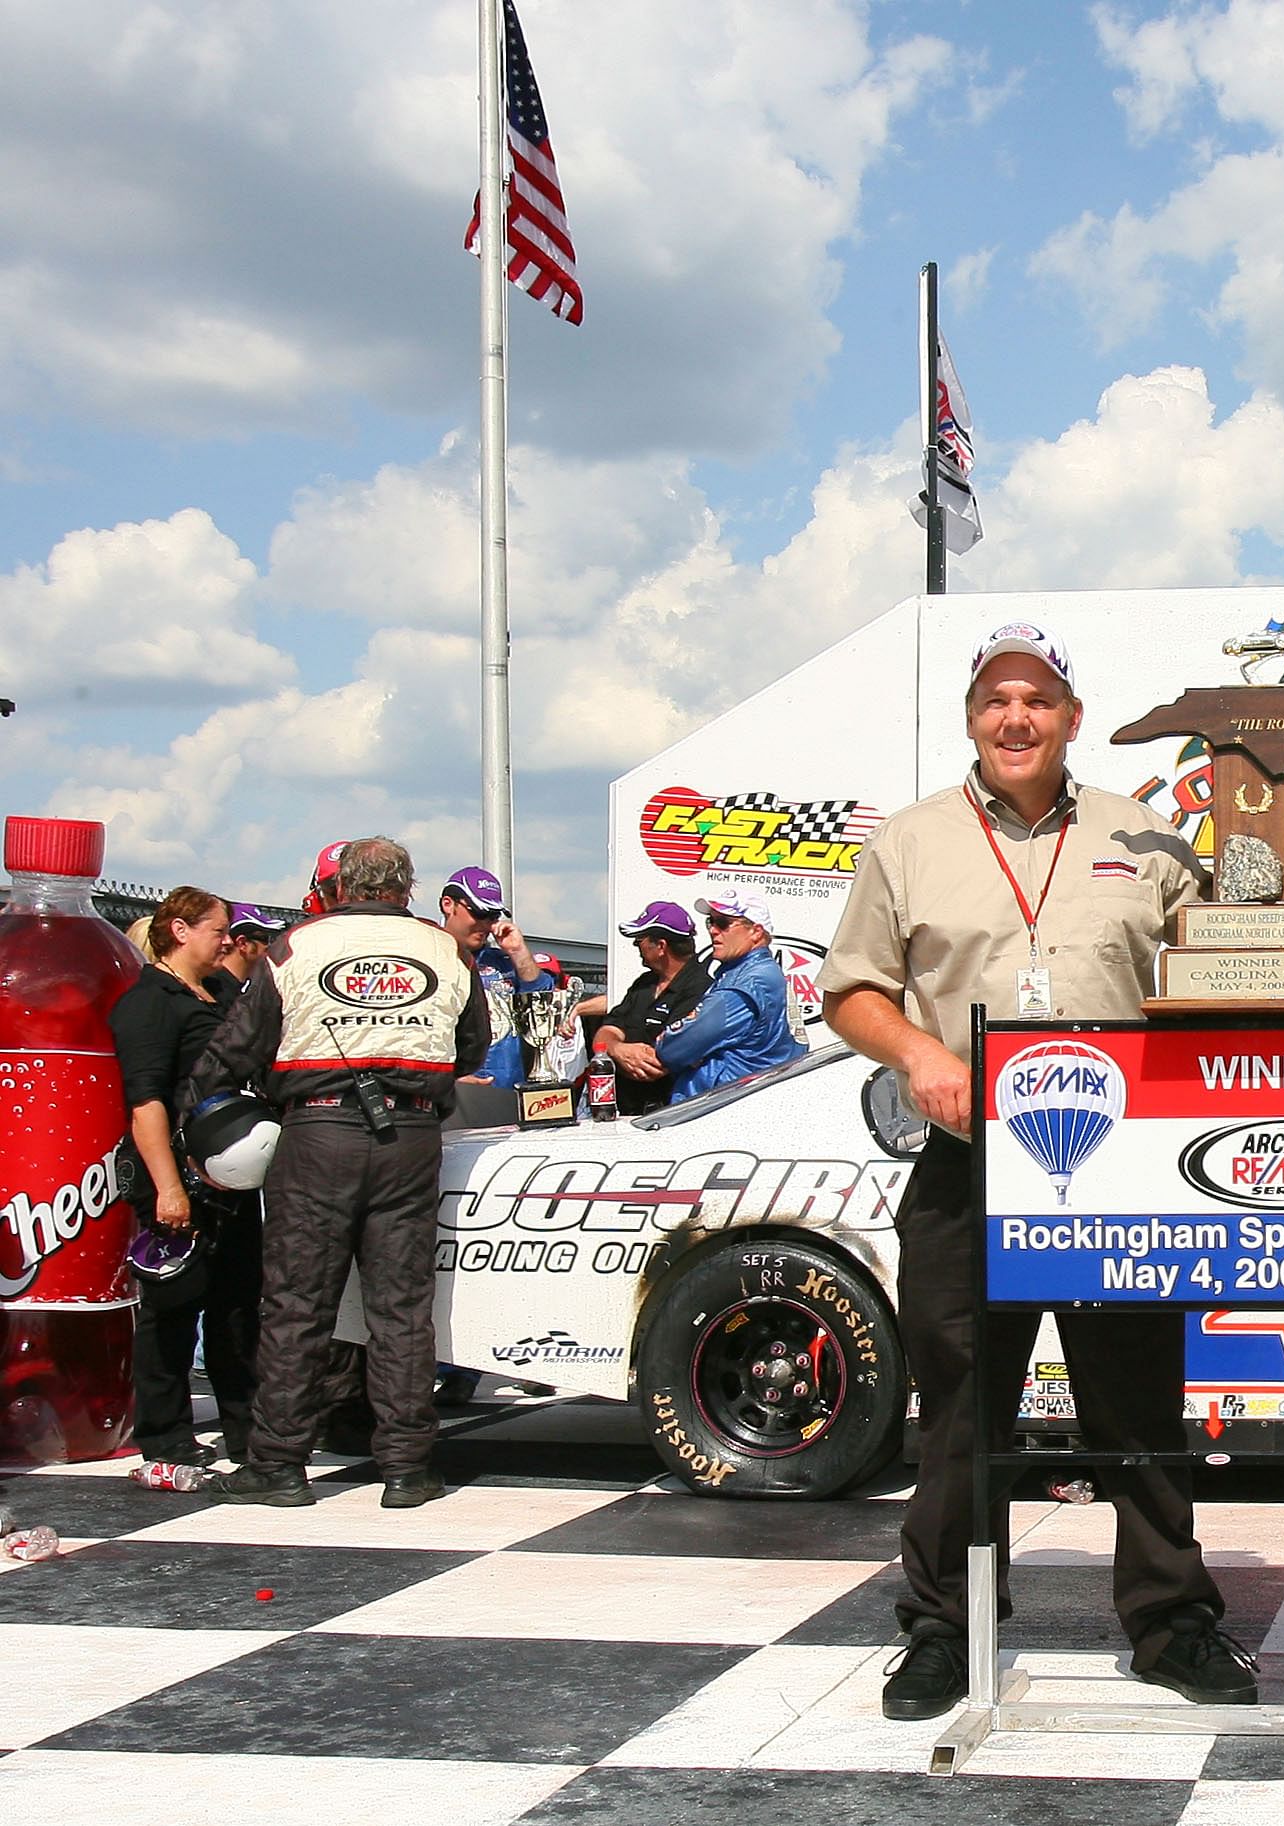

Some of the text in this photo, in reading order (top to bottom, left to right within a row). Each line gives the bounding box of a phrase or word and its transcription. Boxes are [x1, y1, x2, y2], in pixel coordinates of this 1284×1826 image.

[652, 804, 792, 838] FAST
[700, 834, 863, 871] TRACK
[706, 872, 847, 890] HIGH PERFORMANCE DRIVING
[1207, 913, 1257, 925] ROCKINGHAM
[353, 963, 389, 975] ARCA
[1218, 958, 1281, 968] WINNER
[1190, 970, 1279, 980] CAROLINA
[346, 976, 416, 994] RE/MAX
[1209, 982, 1242, 991] MAY
[321, 1015, 433, 1027] OFFICIAL
[1013, 1063, 1109, 1101] RE/MAX
[1002, 1217, 1229, 1257] Rockingham
[436, 1240, 579, 1273] ACING
[741, 1254, 770, 1266] SET
[760, 1269, 786, 1288] RR
[1102, 1259, 1182, 1298] May
[1190, 1258, 1224, 1297] 4,
[795, 1267, 879, 1364] Hoosier
[492, 1346, 625, 1358] VENTURINI
[1036, 1382, 1073, 1394] JES
[652, 1392, 737, 1487] Hoosier
